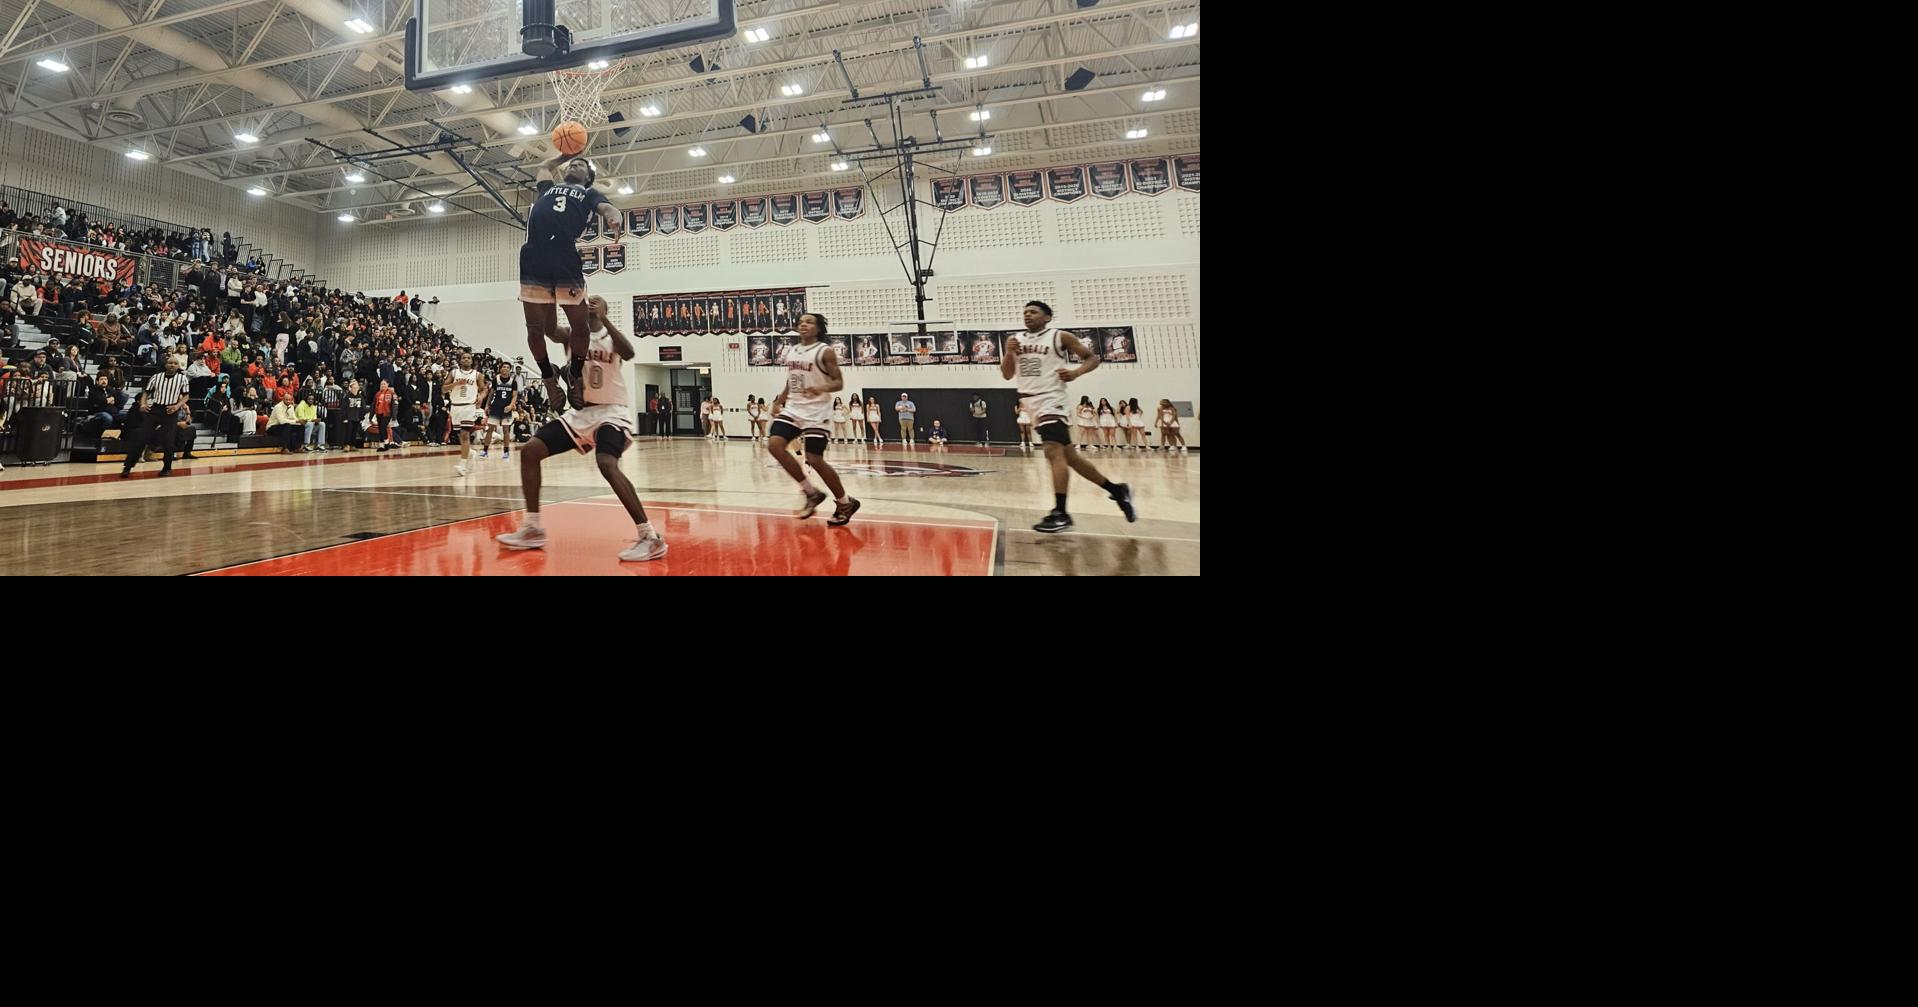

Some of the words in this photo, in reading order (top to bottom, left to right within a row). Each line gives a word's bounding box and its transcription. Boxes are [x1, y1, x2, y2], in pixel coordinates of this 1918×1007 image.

[552, 195, 567, 213] 3
[569, 189, 586, 202] ELM
[40, 247, 117, 281] SENIORS
[1019, 357, 1042, 377] 22
[588, 365, 603, 389] 0
[501, 391, 507, 399] 2
